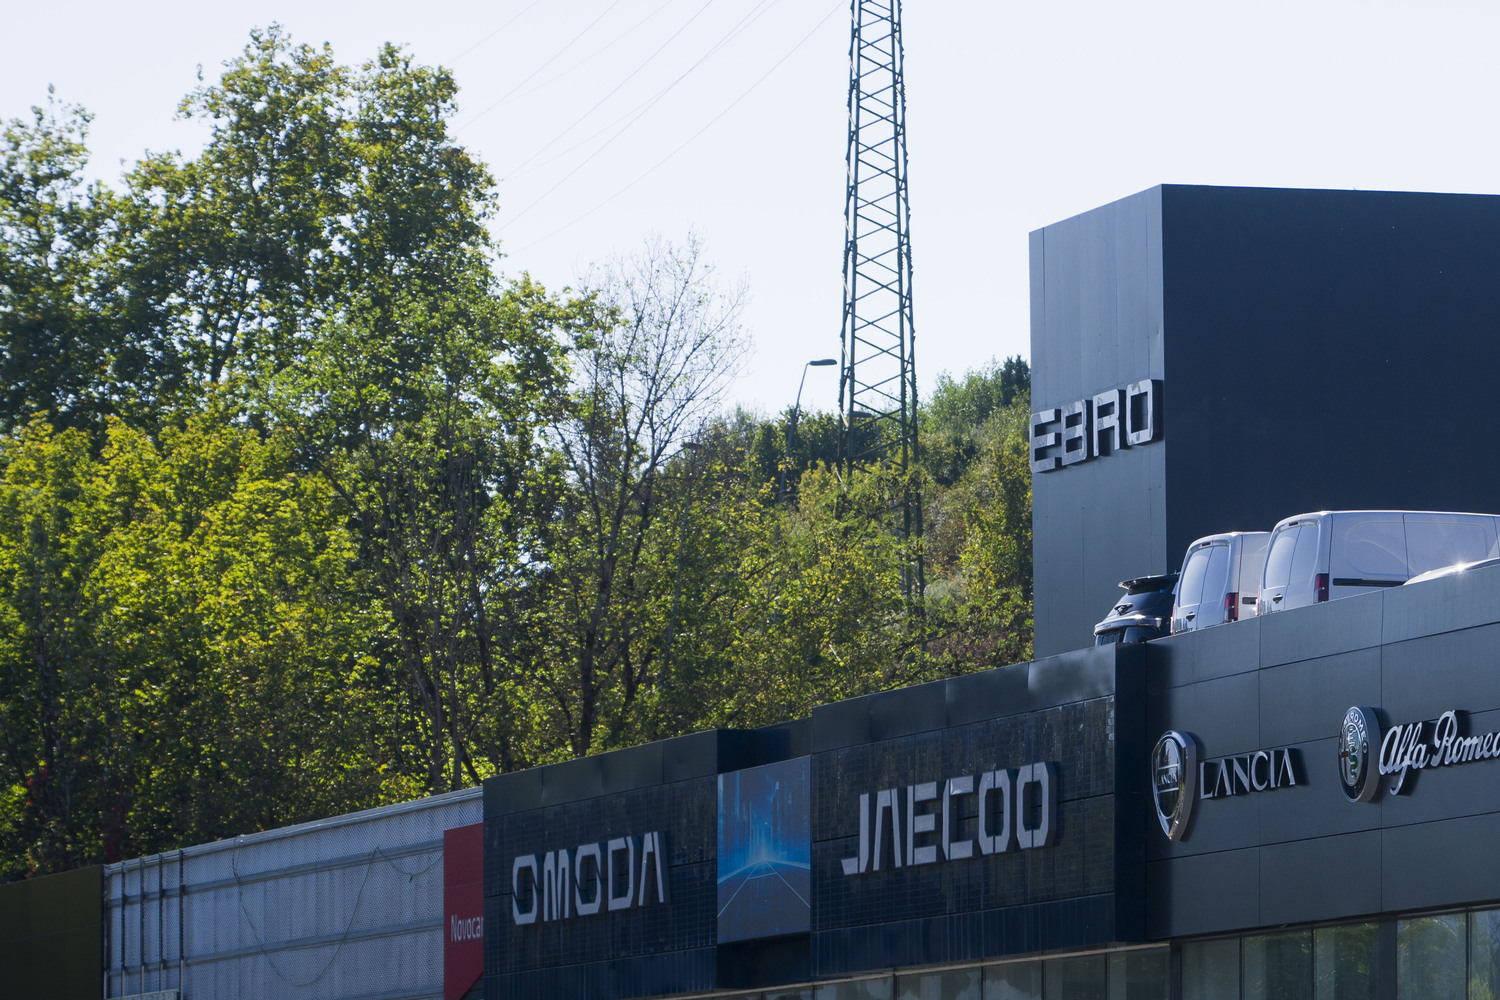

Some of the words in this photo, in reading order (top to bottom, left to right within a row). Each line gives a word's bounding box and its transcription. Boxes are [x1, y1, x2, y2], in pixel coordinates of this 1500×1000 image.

[1030, 378, 1154, 474] EBRO
[1200, 748, 1296, 800] LANCIA
[1378, 721, 1430, 796] Alfa
[840, 761, 1050, 876] JAECOO
[512, 831, 665, 926] OMODA
